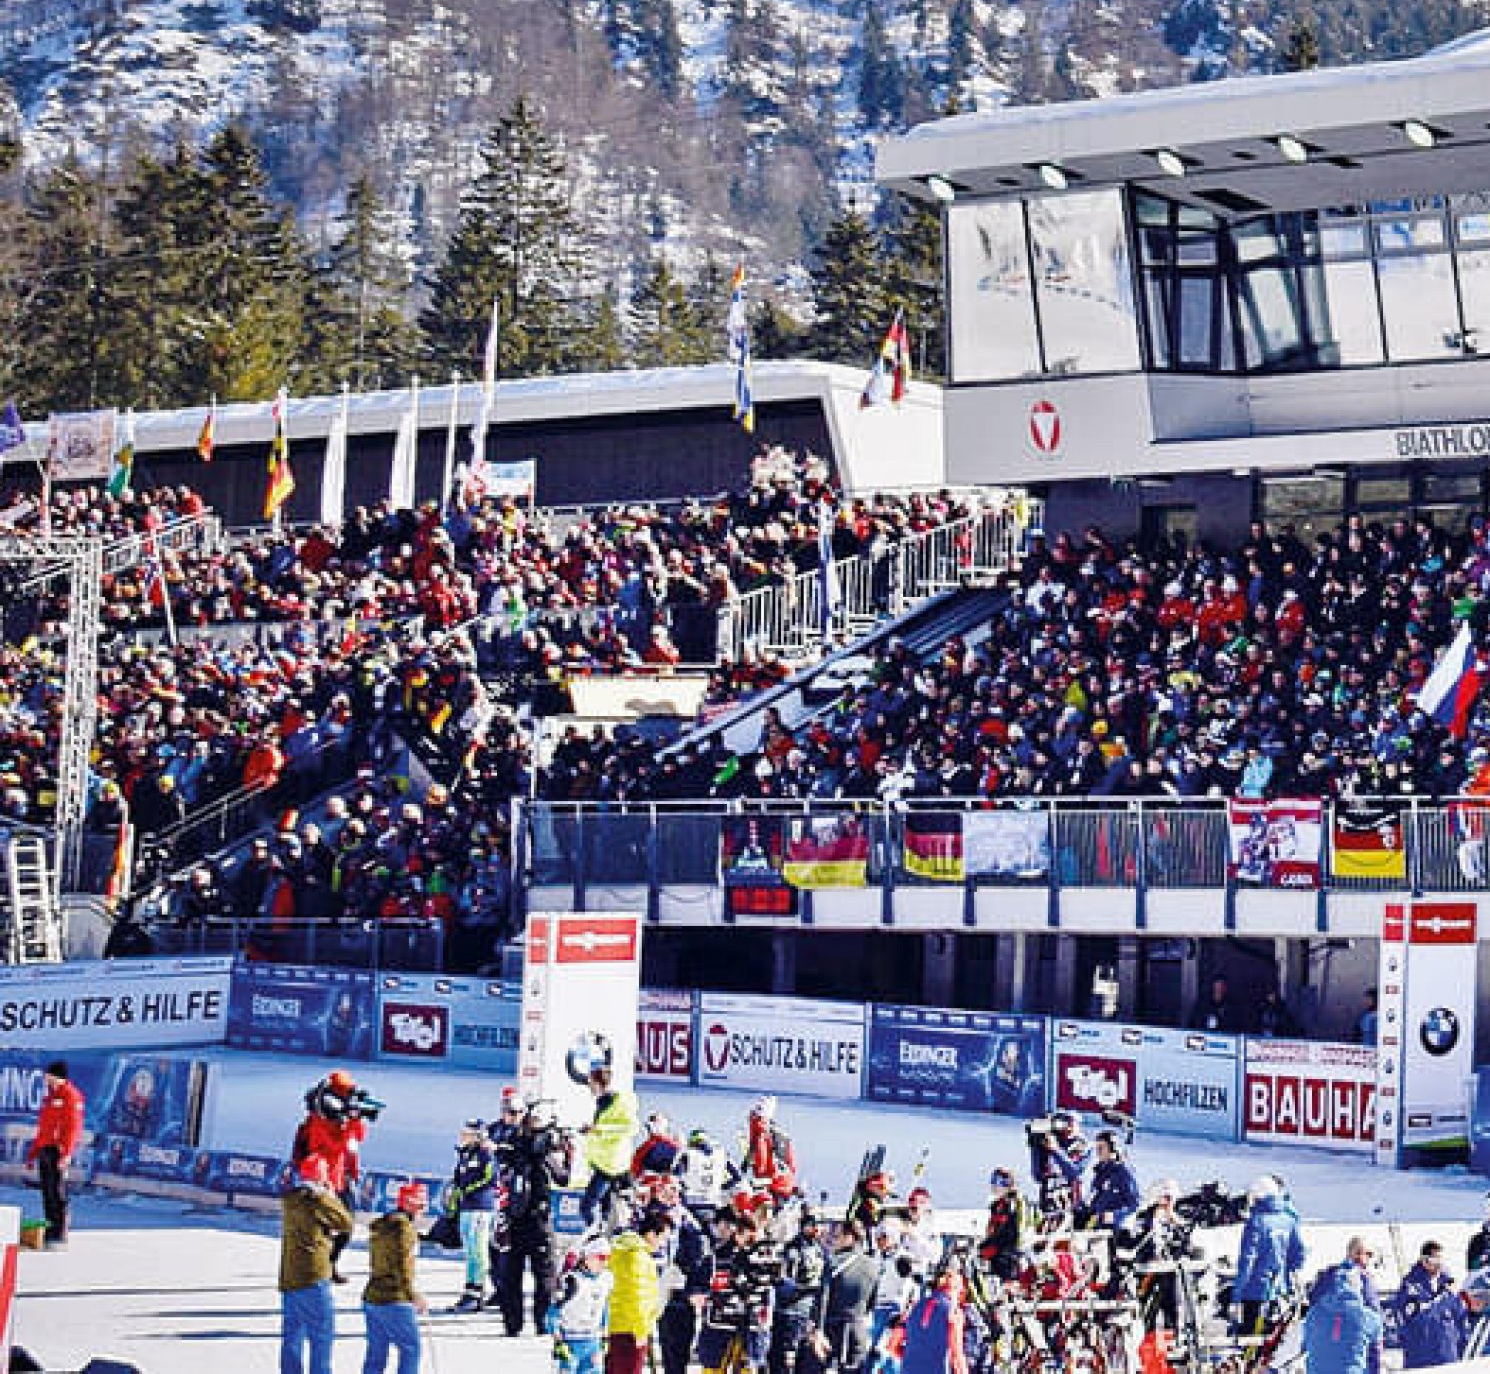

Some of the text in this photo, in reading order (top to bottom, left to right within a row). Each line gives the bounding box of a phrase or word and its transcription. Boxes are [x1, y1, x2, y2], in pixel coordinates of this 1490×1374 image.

[2, 990, 221, 1031] SCHUTZ & HILFE
[730, 1032, 858, 1074] SCHUTZ & HILFE
[1143, 1078, 1228, 1113] HOCHFILZEN
